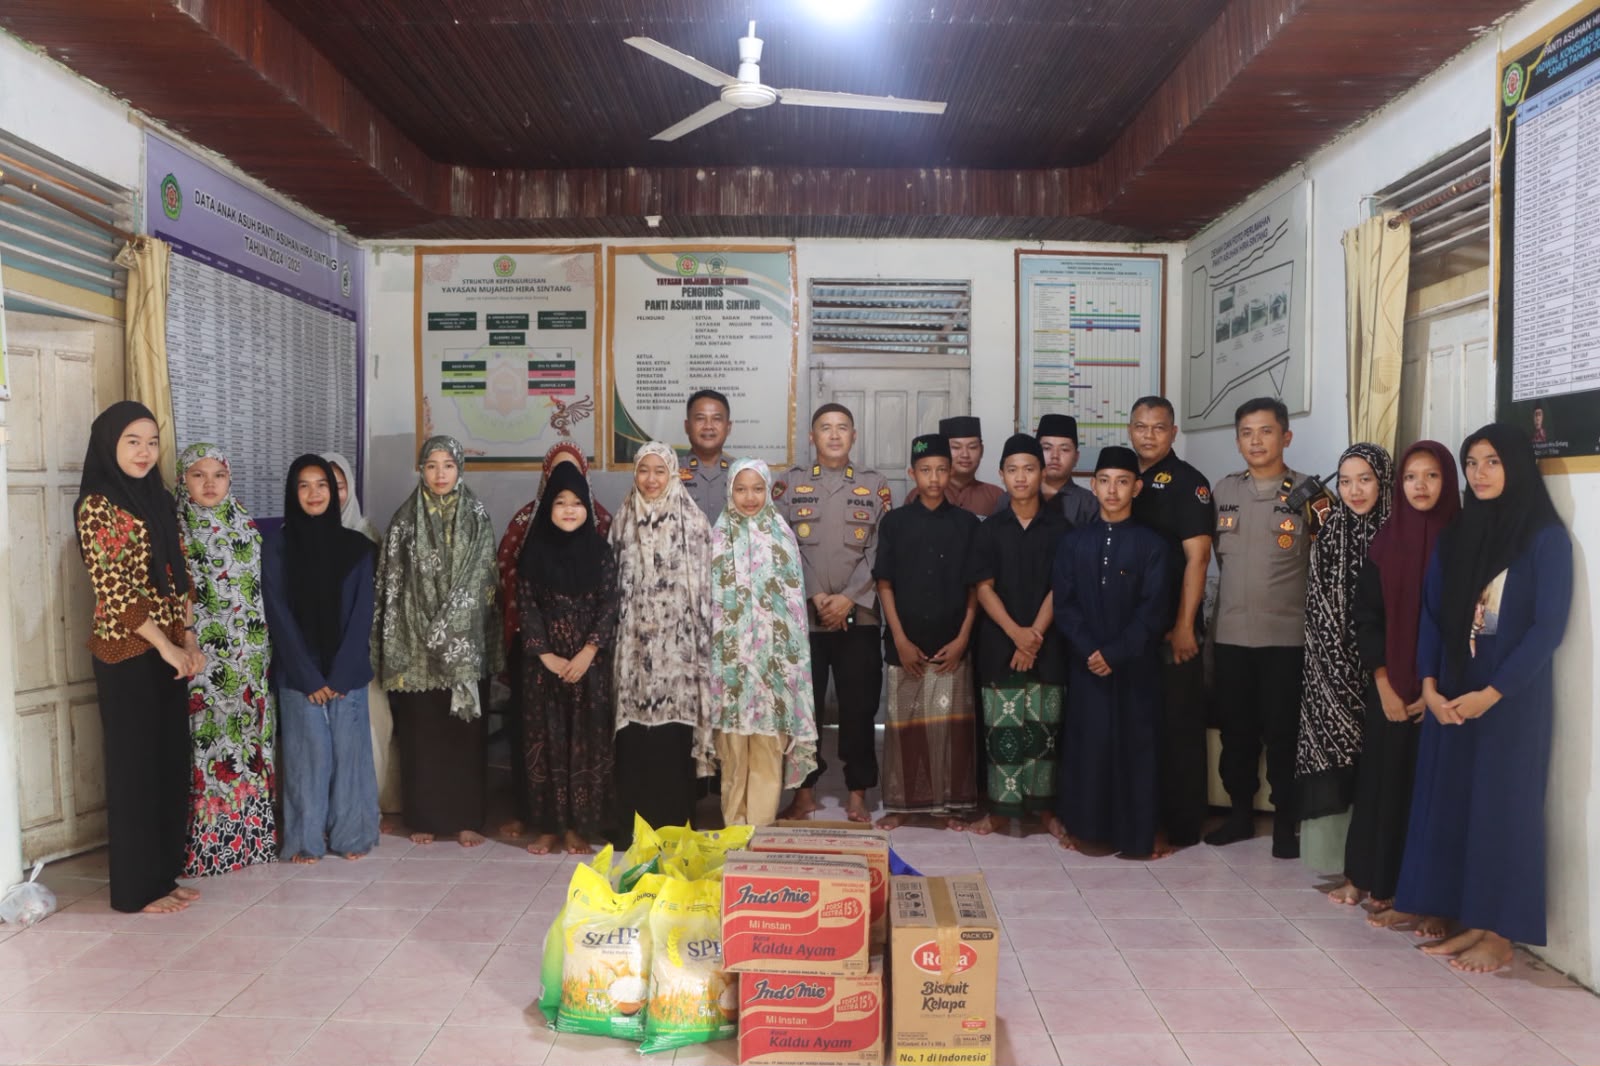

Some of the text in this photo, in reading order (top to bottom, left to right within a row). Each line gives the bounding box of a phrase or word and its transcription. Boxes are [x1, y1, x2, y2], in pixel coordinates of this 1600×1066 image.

[1563, 18, 1592, 46] ASUHAN
[194, 190, 215, 213] DATA
[217, 202, 237, 222] ANAK
[237, 212, 256, 231] ASUH
[257, 221, 275, 241] PANTI
[275, 231, 300, 252] ASUHAN
[244, 235, 269, 259] TAHUN
[269, 247, 284, 266] 2024
[479, 286, 514, 294] MUJAHID
[681, 287, 723, 298] PENGURUS
[644, 299, 760, 311] PANTI ASUHAN HIRA SINTANG
[847, 499, 874, 507] POLRI
[749, 920, 791, 930] Mi Instan
[752, 942, 837, 960] Kaldu Ayam
[922, 951, 968, 966] Roa
[921, 981, 969, 996] Biskuit
[922, 997, 966, 1013] Kelapa
[766, 1015, 807, 1025] Mi Instan
[769, 1035, 852, 1052] Kaldu Ayam
[900, 1053, 986, 1062] No. 1 di Indonesia
